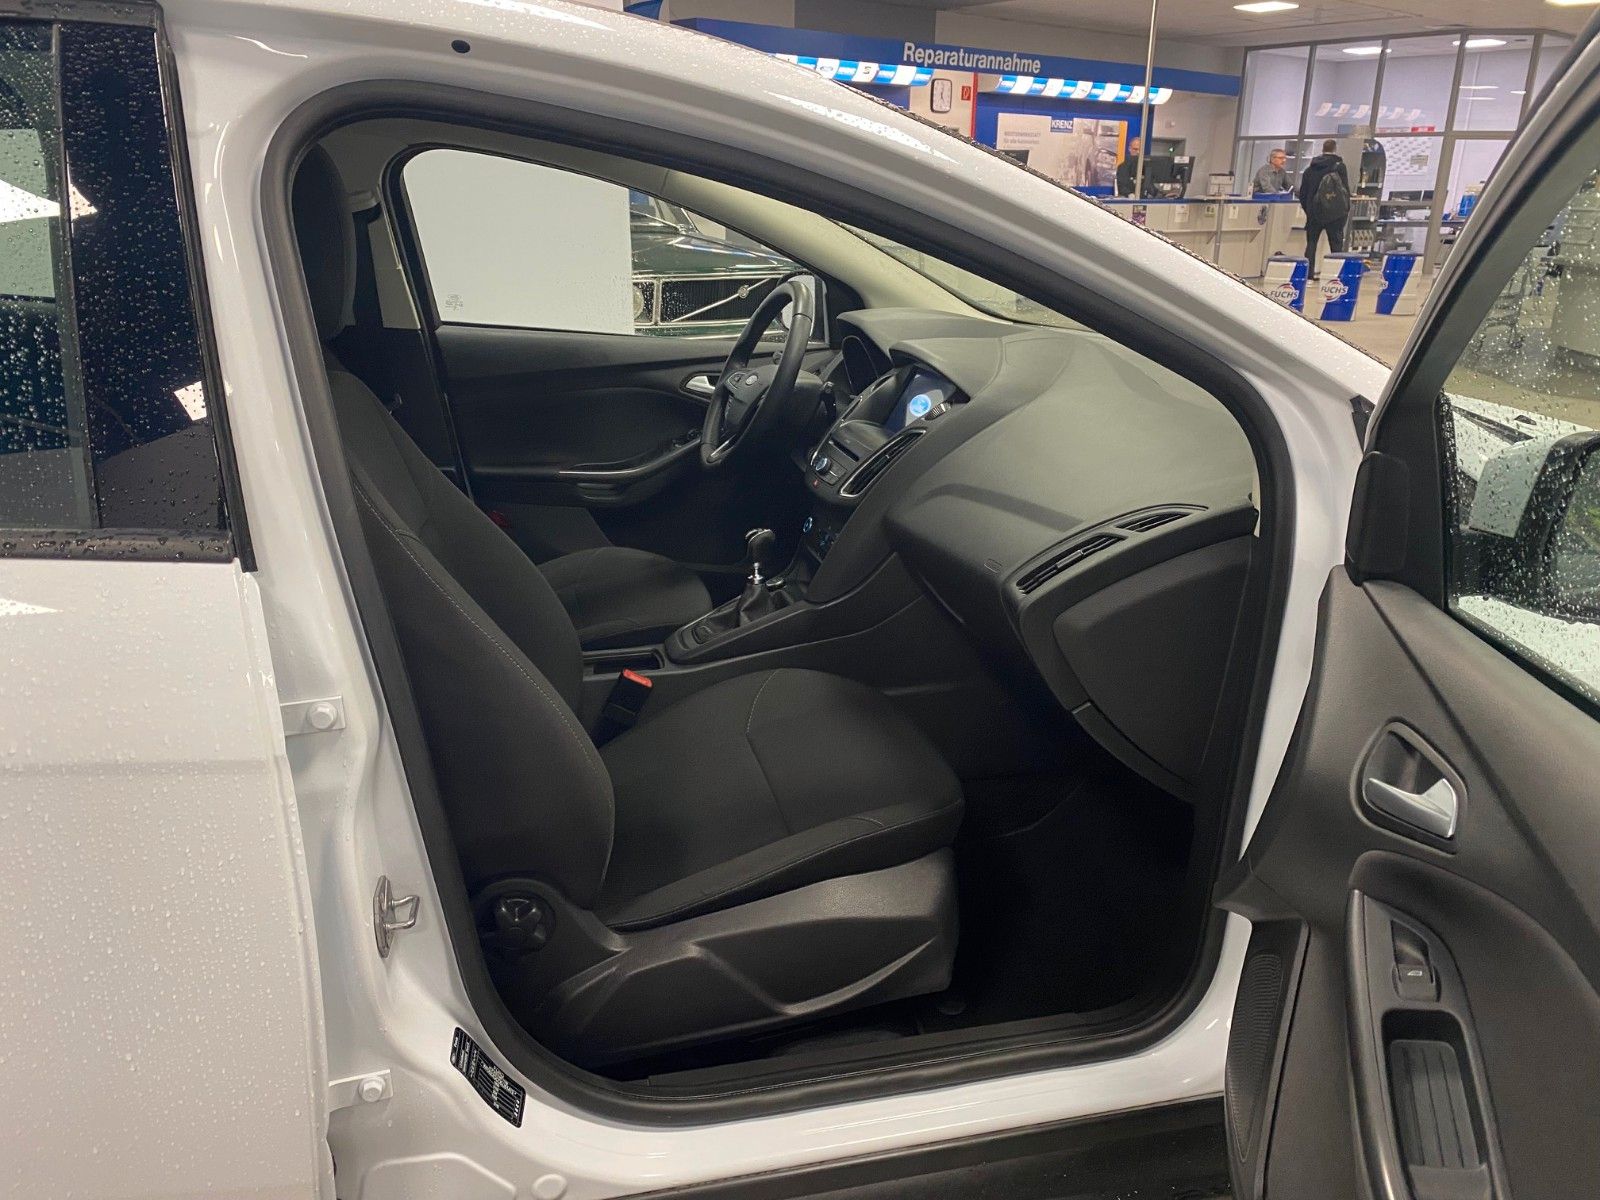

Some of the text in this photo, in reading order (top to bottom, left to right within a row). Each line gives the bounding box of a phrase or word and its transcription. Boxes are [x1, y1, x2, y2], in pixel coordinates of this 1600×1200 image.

[903, 42, 1041, 74] Reparaturannahme
[1051, 120, 1073, 129] KRENZ
[1270, 290, 1299, 299] FUCHS
[1321, 286, 1347, 294] FUCHS
